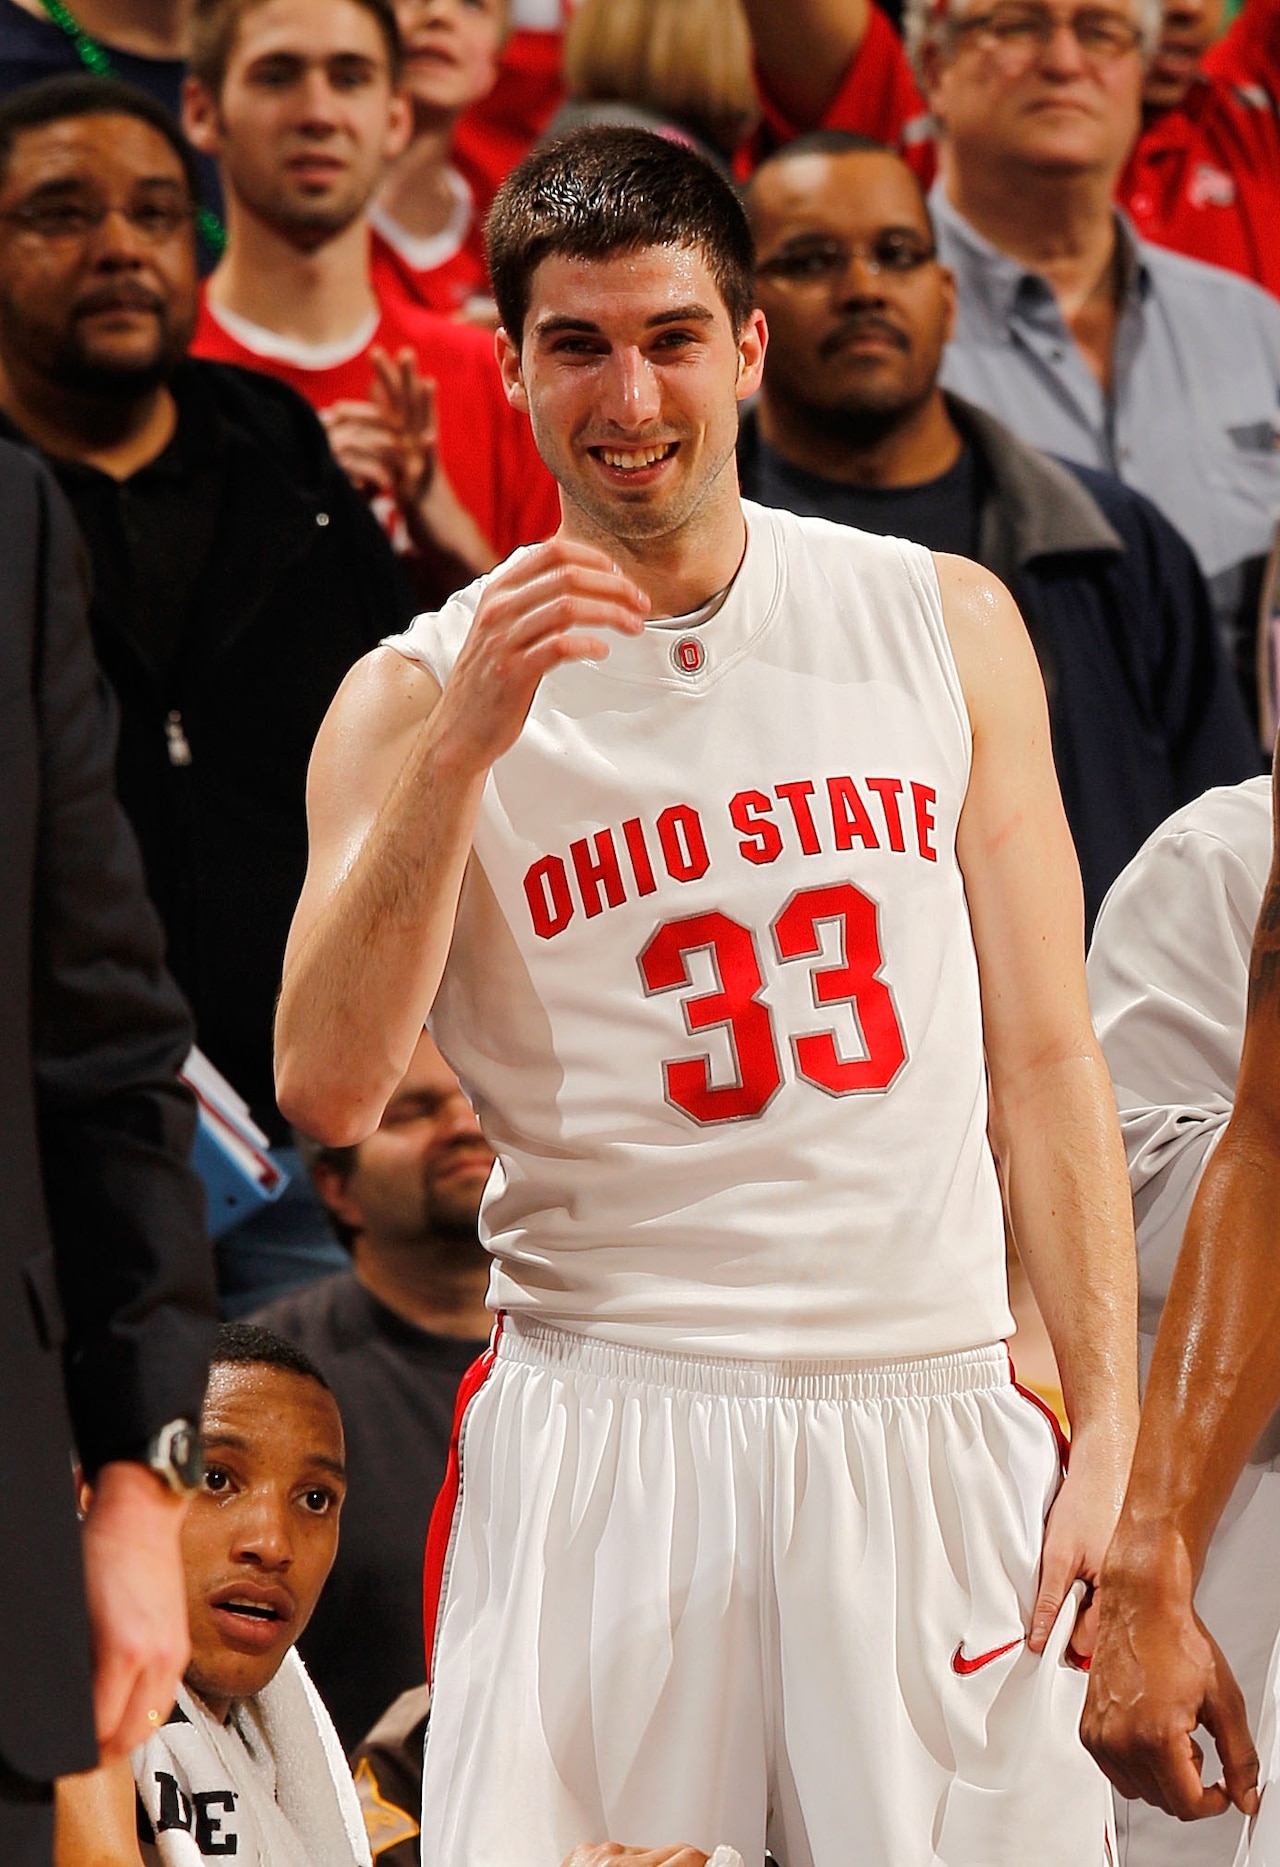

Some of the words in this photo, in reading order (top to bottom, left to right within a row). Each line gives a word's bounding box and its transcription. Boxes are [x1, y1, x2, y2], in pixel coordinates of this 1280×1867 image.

[522, 803, 711, 940] OHIO
[728, 775, 938, 866] STATE
[635, 878, 911, 1128] 33
